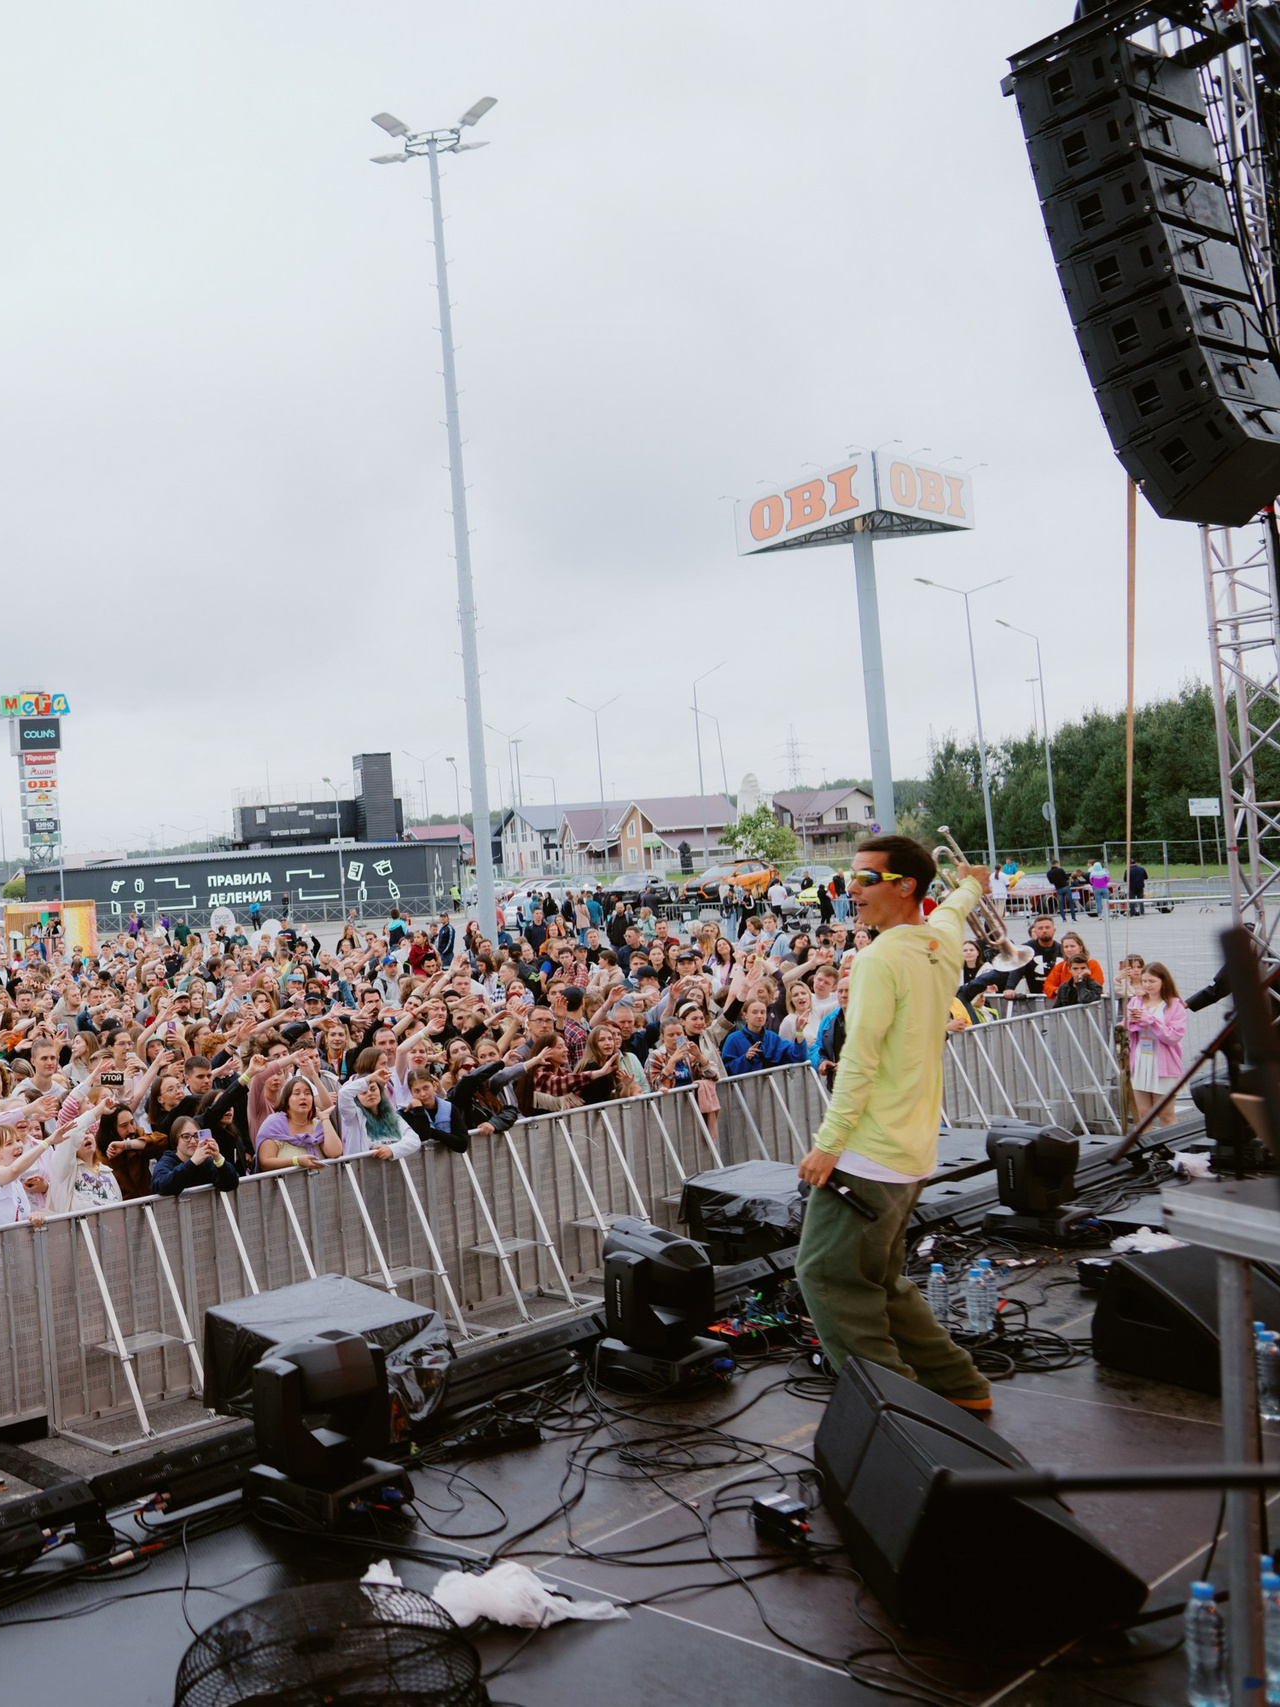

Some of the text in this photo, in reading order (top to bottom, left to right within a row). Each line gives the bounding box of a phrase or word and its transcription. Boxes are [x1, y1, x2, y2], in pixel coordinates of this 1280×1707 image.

[890, 461, 967, 519] OBI
[750, 464, 860, 541] OBI
[23, 728, 56, 739] COLIN'S
[27, 780, 57, 789] OBI
[207, 871, 272, 888] ПРАВИЛА
[208, 889, 272, 908] ДЕЛЕНИЯ
